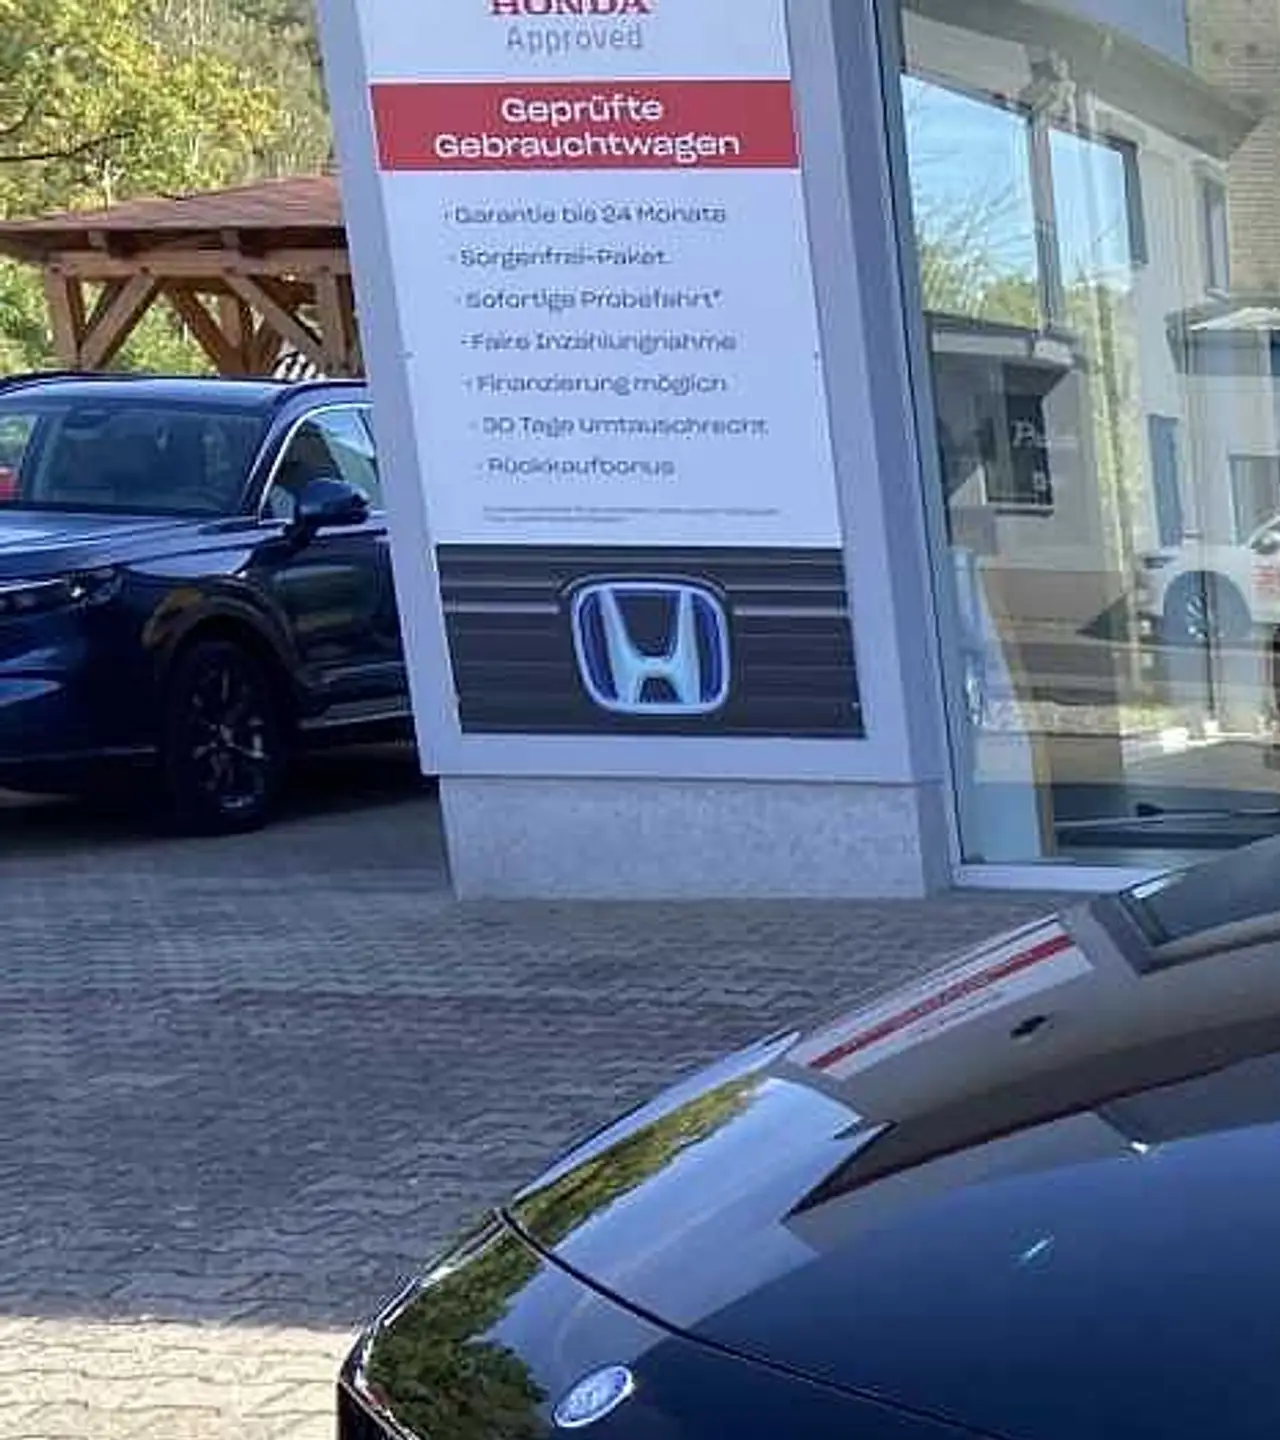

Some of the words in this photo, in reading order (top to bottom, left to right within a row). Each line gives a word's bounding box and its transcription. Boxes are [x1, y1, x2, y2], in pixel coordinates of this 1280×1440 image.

[490, 0, 650, 15] HONDA
[506, 25, 643, 54] Approved
[500, 96, 664, 126] Geprüfte
[434, 130, 741, 163] Gebrauchtwagen
[455, 205, 556, 224] Garantie
[561, 205, 596, 224] bis
[602, 205, 632, 224] 24
[638, 205, 726, 224] Monate
[460, 248, 671, 270] Sorgenfrei-Paket
[466, 290, 575, 313] Sofortige
[536, 332, 737, 354] Inzahlungnahme
[477, 375, 630, 396] Finanzierung
[634, 375, 727, 396] möglich
[519, 417, 575, 437] Tage
[488, 457, 675, 476] Rückkaufbonus
